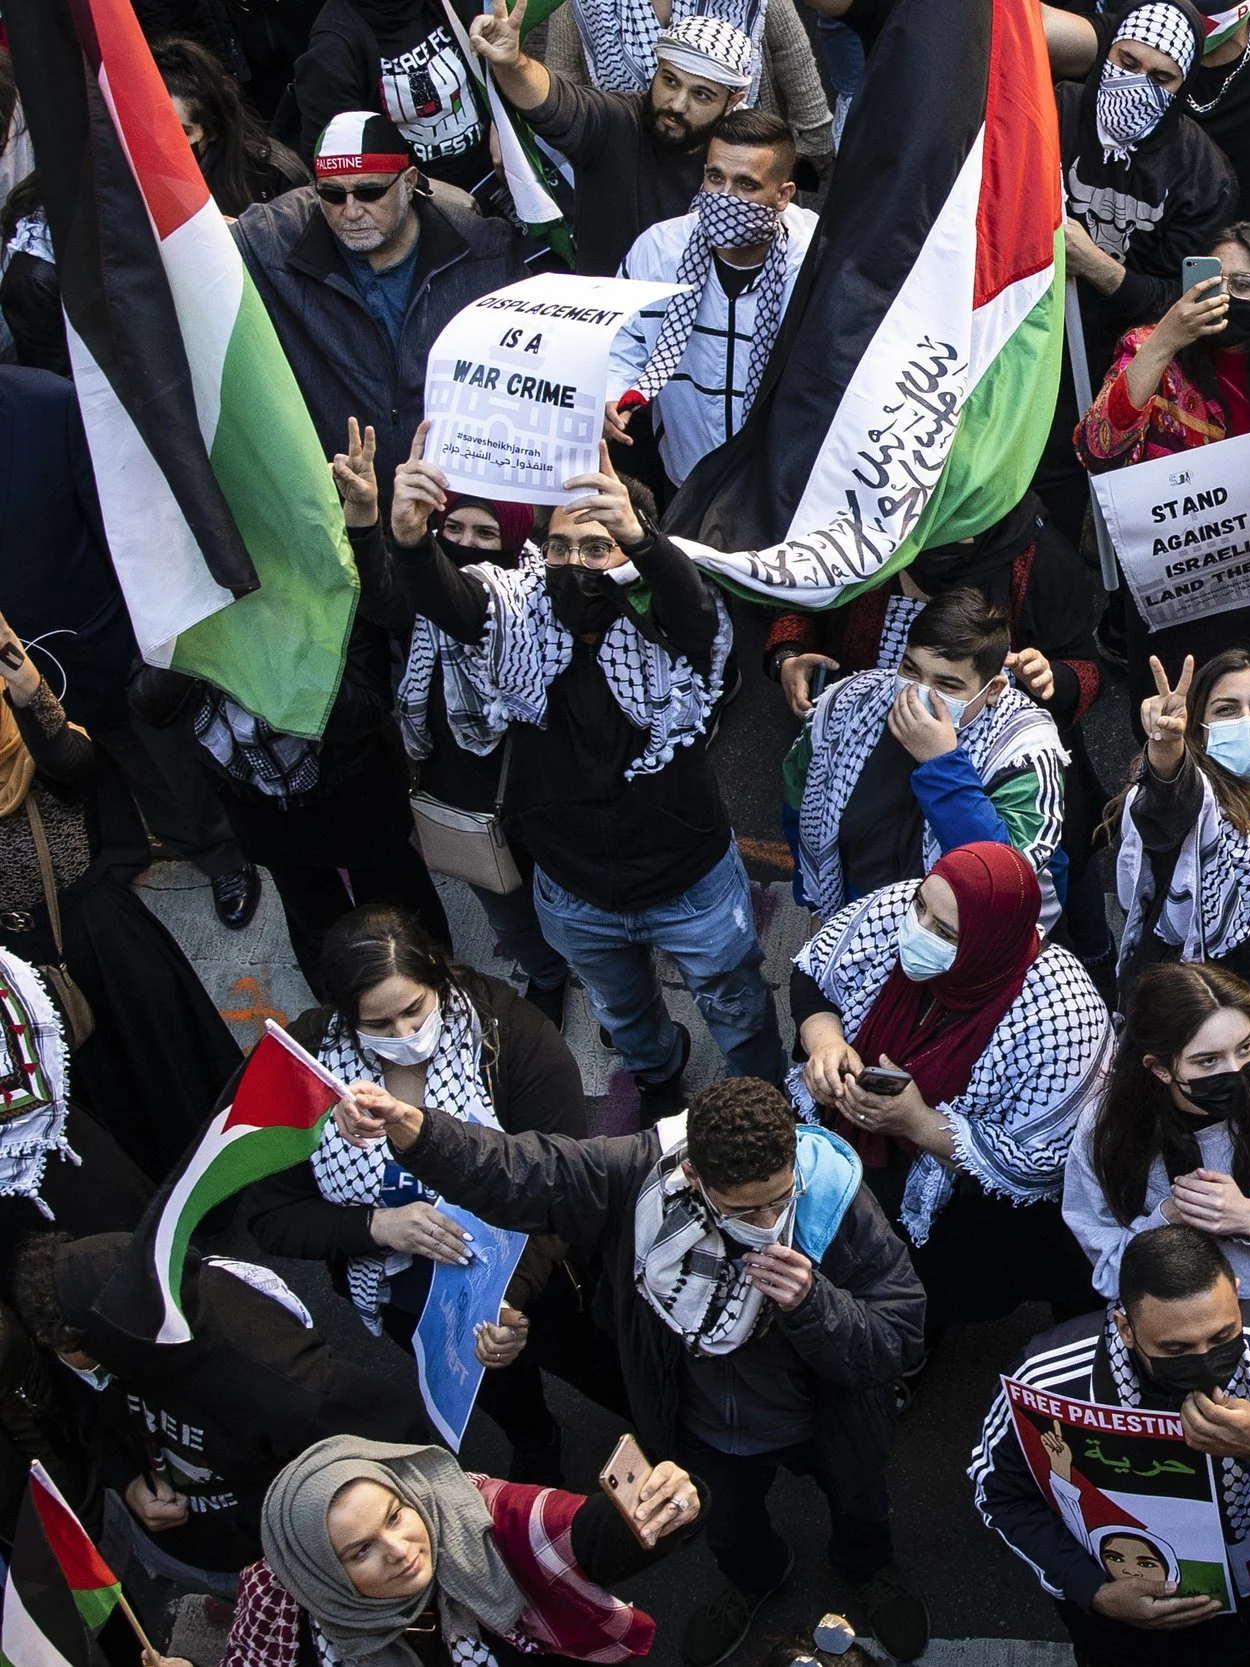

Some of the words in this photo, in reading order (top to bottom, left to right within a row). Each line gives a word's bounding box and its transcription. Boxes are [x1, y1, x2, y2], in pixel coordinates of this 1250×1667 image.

[316, 157, 362, 170] PALESTINE
[476, 297, 624, 327] DISPLACEMENT
[499, 327, 524, 349] IS
[524, 333, 543, 355] A
[453, 359, 500, 391] WAR
[506, 373, 577, 409] CRIME
[457, 432, 541, 458] #savesheikhjarrah
[1151, 487, 1228, 523] STAND
[1152, 513, 1248, 556] AGAINST
[1145, 579, 1204, 606] LAND
[1009, 1384, 1063, 1418] FREE
[1068, 1405, 1183, 1436] PALESTIN
[1084, 1438, 1196, 1477] حرية
